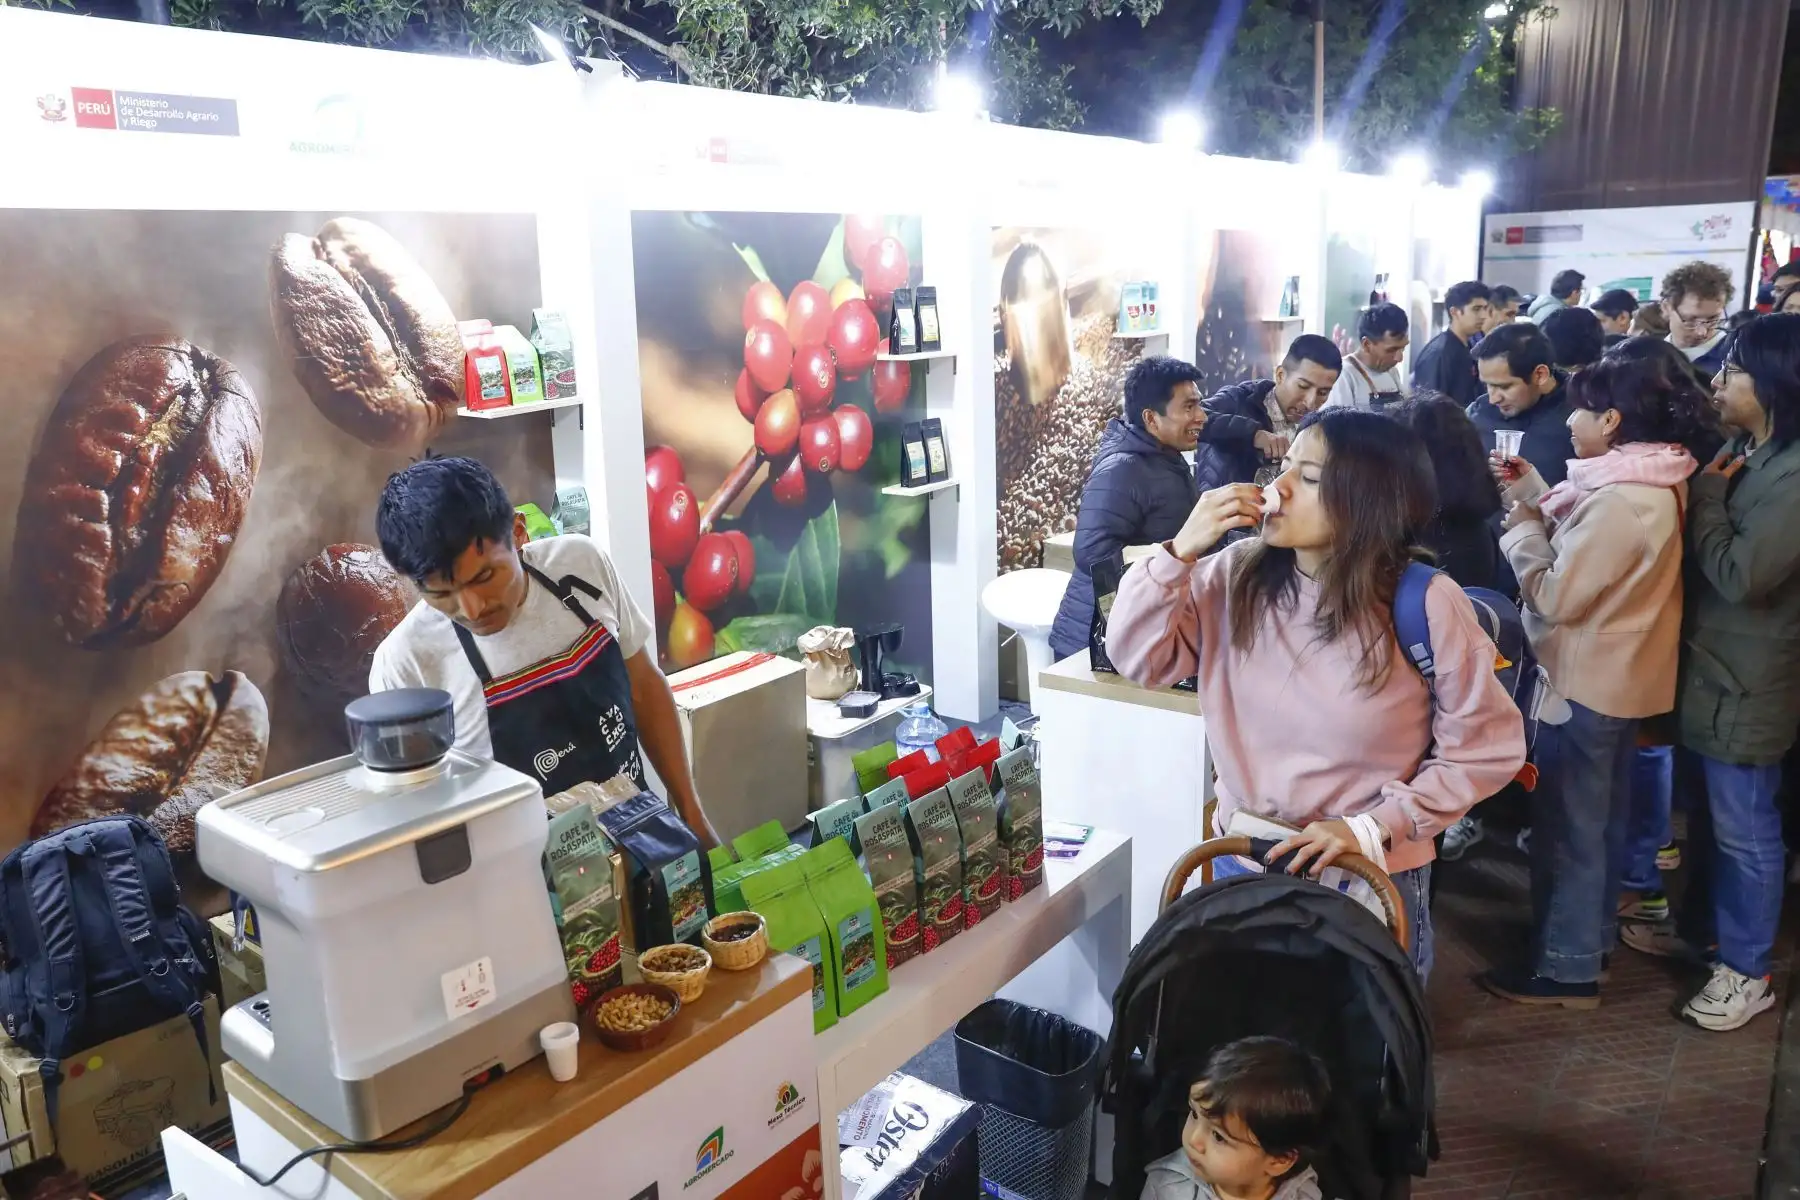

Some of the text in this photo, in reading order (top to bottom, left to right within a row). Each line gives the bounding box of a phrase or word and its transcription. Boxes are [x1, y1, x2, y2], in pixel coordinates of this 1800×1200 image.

[77, 100, 111, 116] PERÚ
[119, 95, 169, 109] Ministerio
[120, 106, 219, 123] de Desarrollo Agrario
[122, 116, 157, 128] y Riego
[1004, 766, 1034, 787] ROSASPATA
[956, 787, 989, 810] ROSASPATA
[917, 808, 951, 831] ROSASPATA
[824, 825, 852, 841] ROSASP
[864, 824, 903, 848] ROSASPATA
[550, 831, 597, 862] ROSASPATA
[864, 1101, 930, 1172] Oster
[683, 1150, 735, 1190] AGROMERCADO
